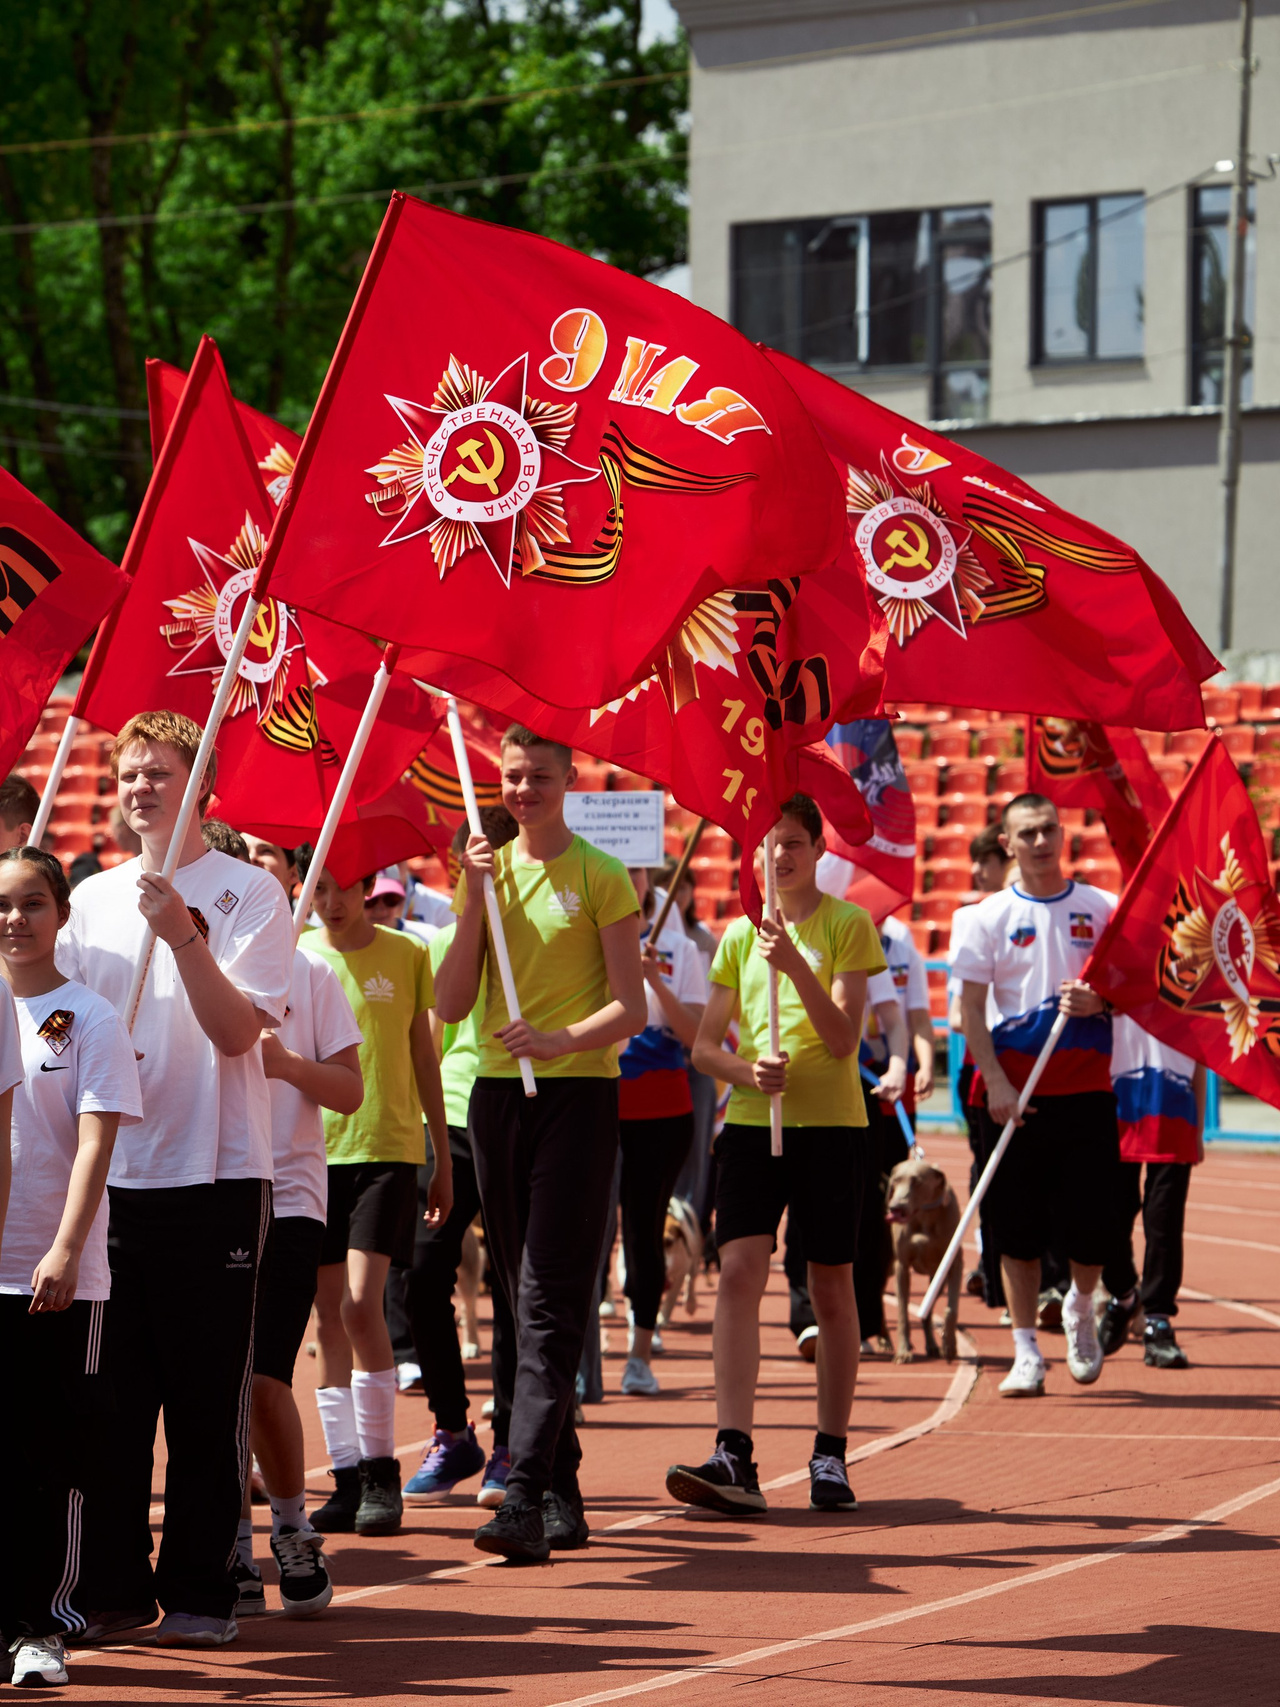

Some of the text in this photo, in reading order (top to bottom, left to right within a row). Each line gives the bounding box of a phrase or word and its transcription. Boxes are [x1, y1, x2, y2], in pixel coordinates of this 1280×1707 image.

[539, 308, 772, 445] 9 МАЯ
[427, 407, 534, 502] ОТЕЧЕСТВЕННАЯ
